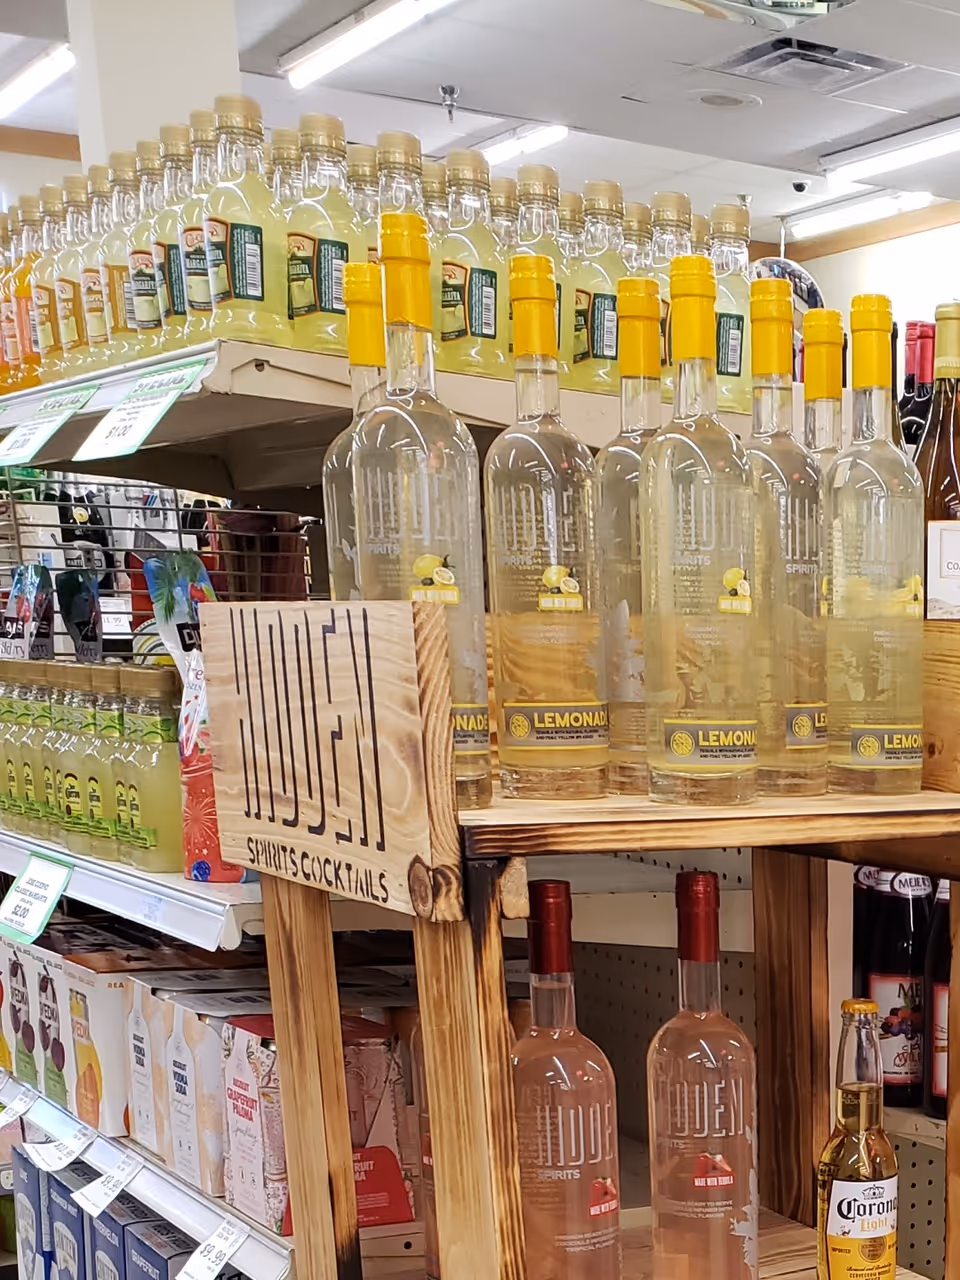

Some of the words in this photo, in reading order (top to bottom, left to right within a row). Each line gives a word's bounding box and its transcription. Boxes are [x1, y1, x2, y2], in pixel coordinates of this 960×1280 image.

[228, 606, 387, 852] HIDDEN
[247, 836, 300, 879] SPIRITS
[300, 857, 390, 904] COCKTAILS
[227, 1087, 258, 1112] GRAPEFRUIT
[232, 1101, 254, 1123] PALOMA
[668, 1077, 745, 1138] IDDEN
[859, 1217, 889, 1232] Light
[200, 1242, 226, 1267] $9.99
